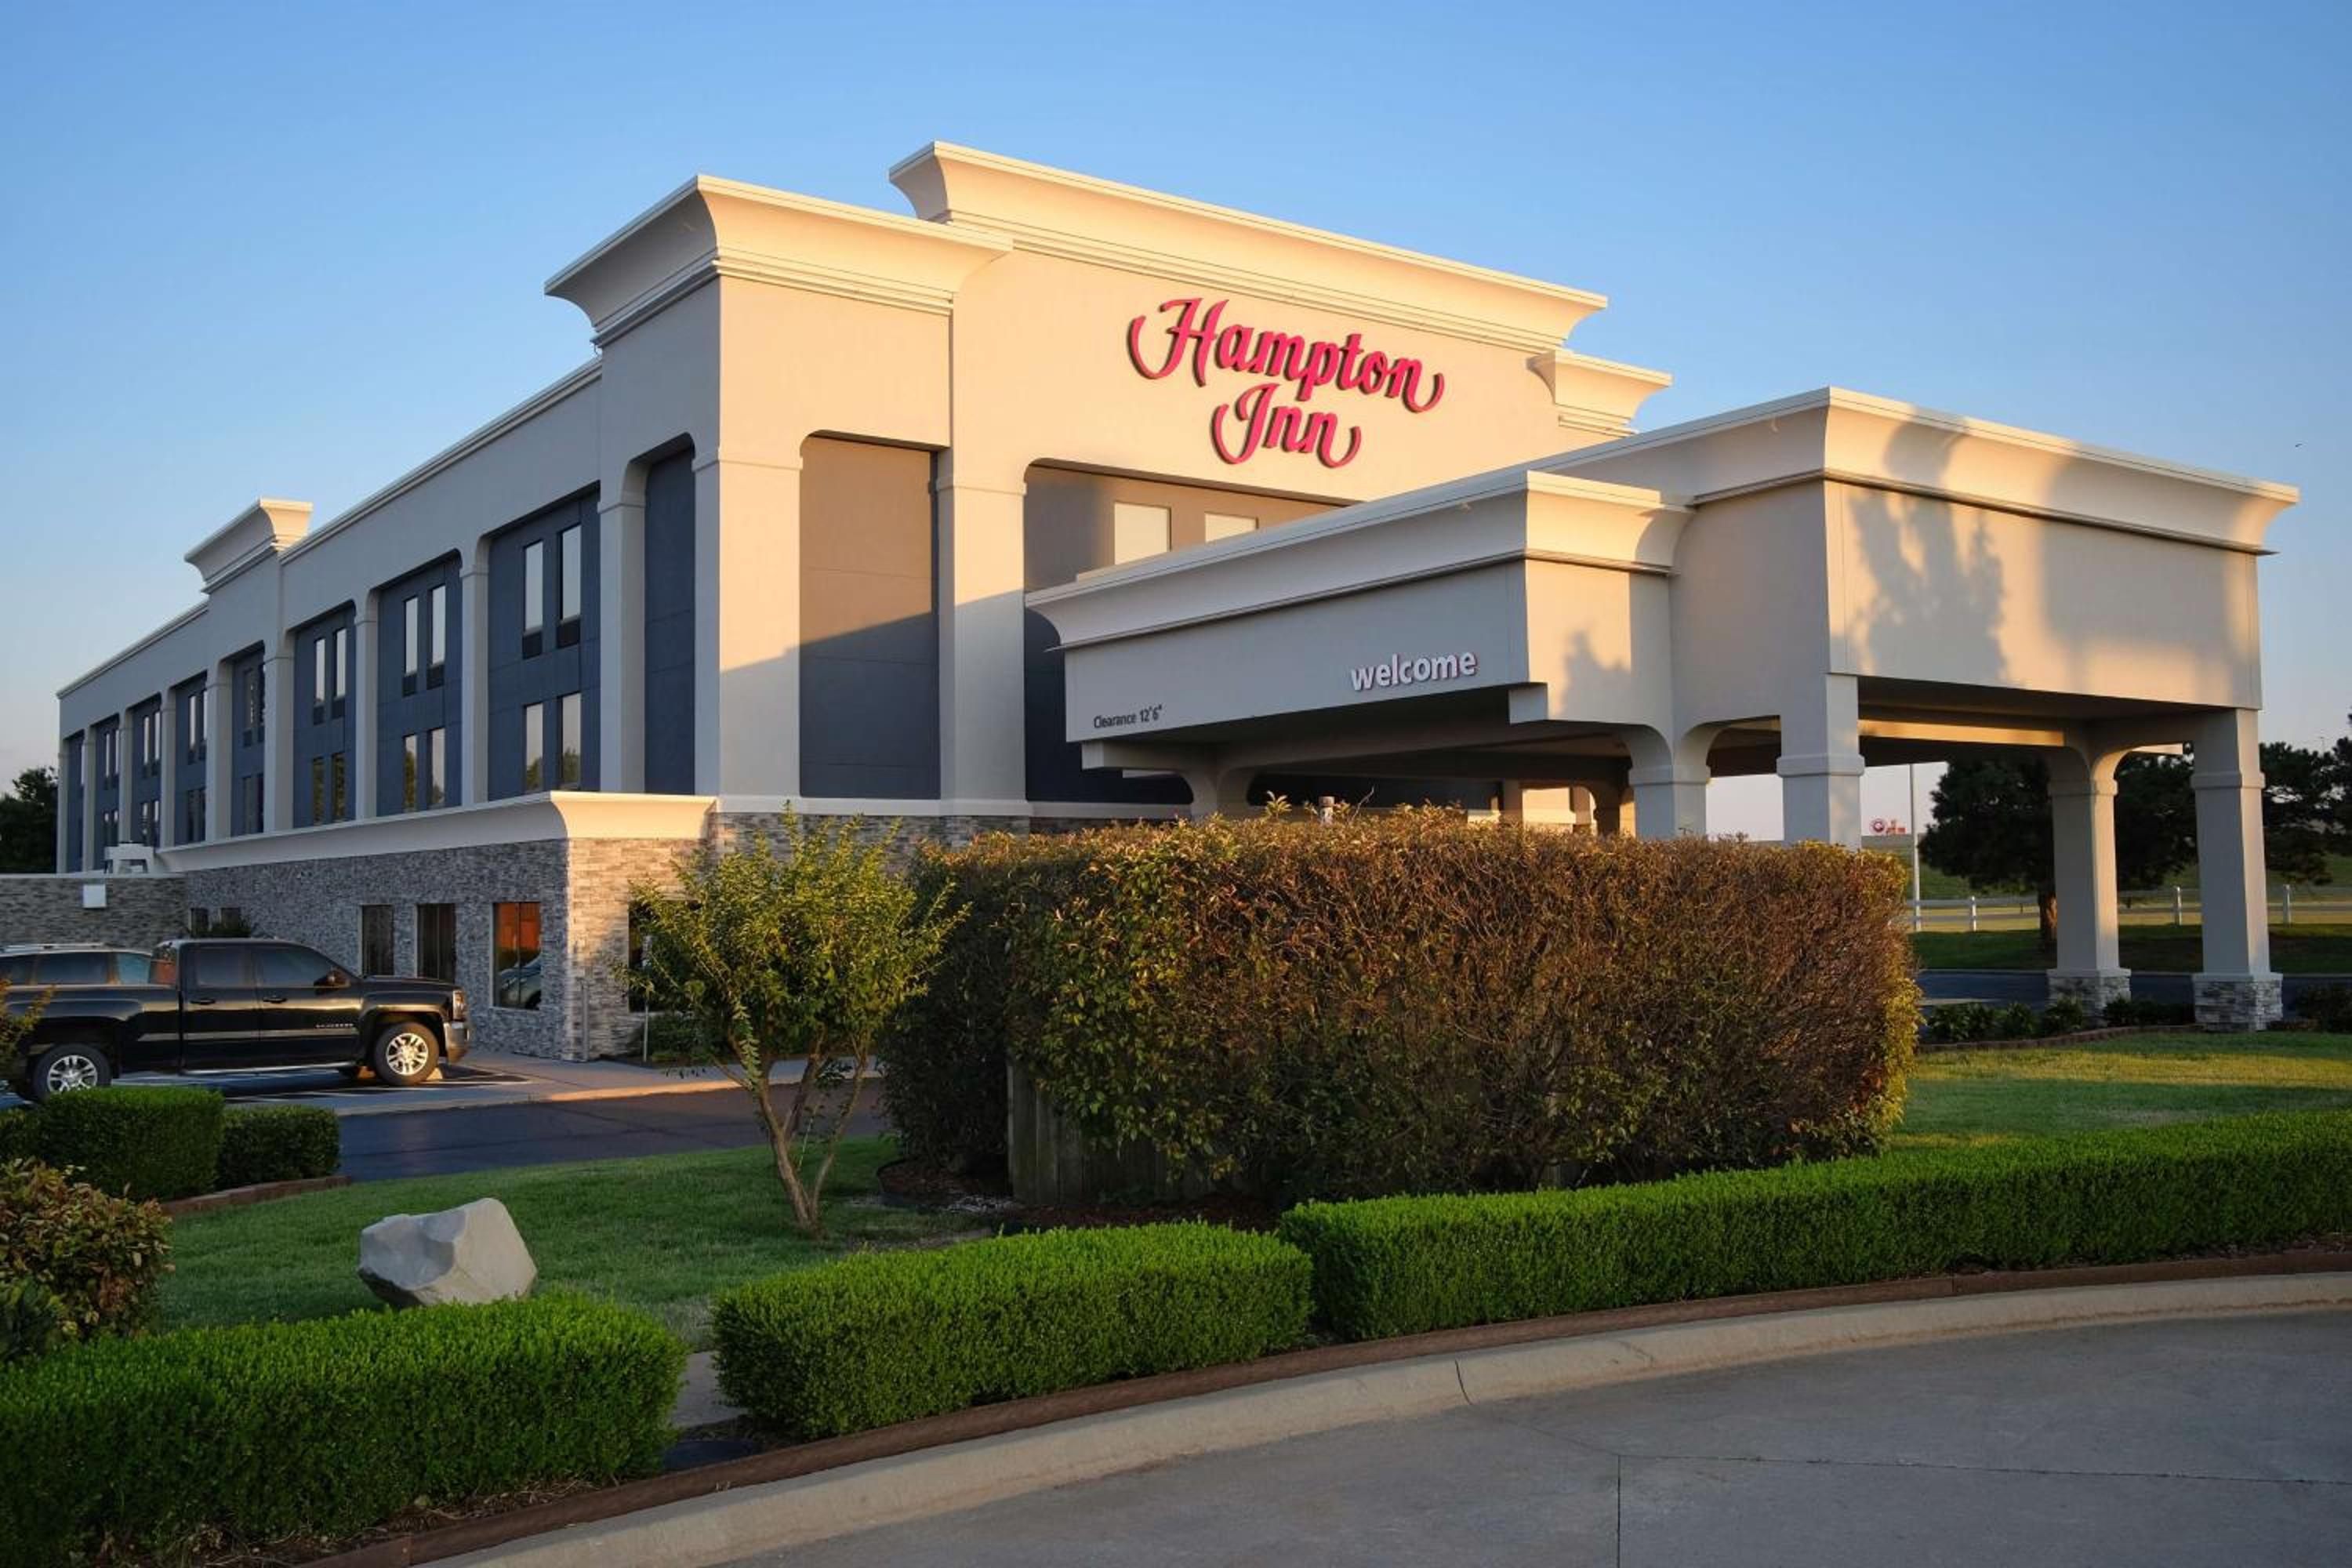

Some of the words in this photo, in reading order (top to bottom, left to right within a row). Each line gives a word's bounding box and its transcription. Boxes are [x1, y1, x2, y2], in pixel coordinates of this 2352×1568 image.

[1127, 297, 1445, 413] Hampton
[1210, 383, 1362, 468] Inn
[1351, 652, 1477, 691] welcome
[1093, 713, 1136, 728] Clearance
